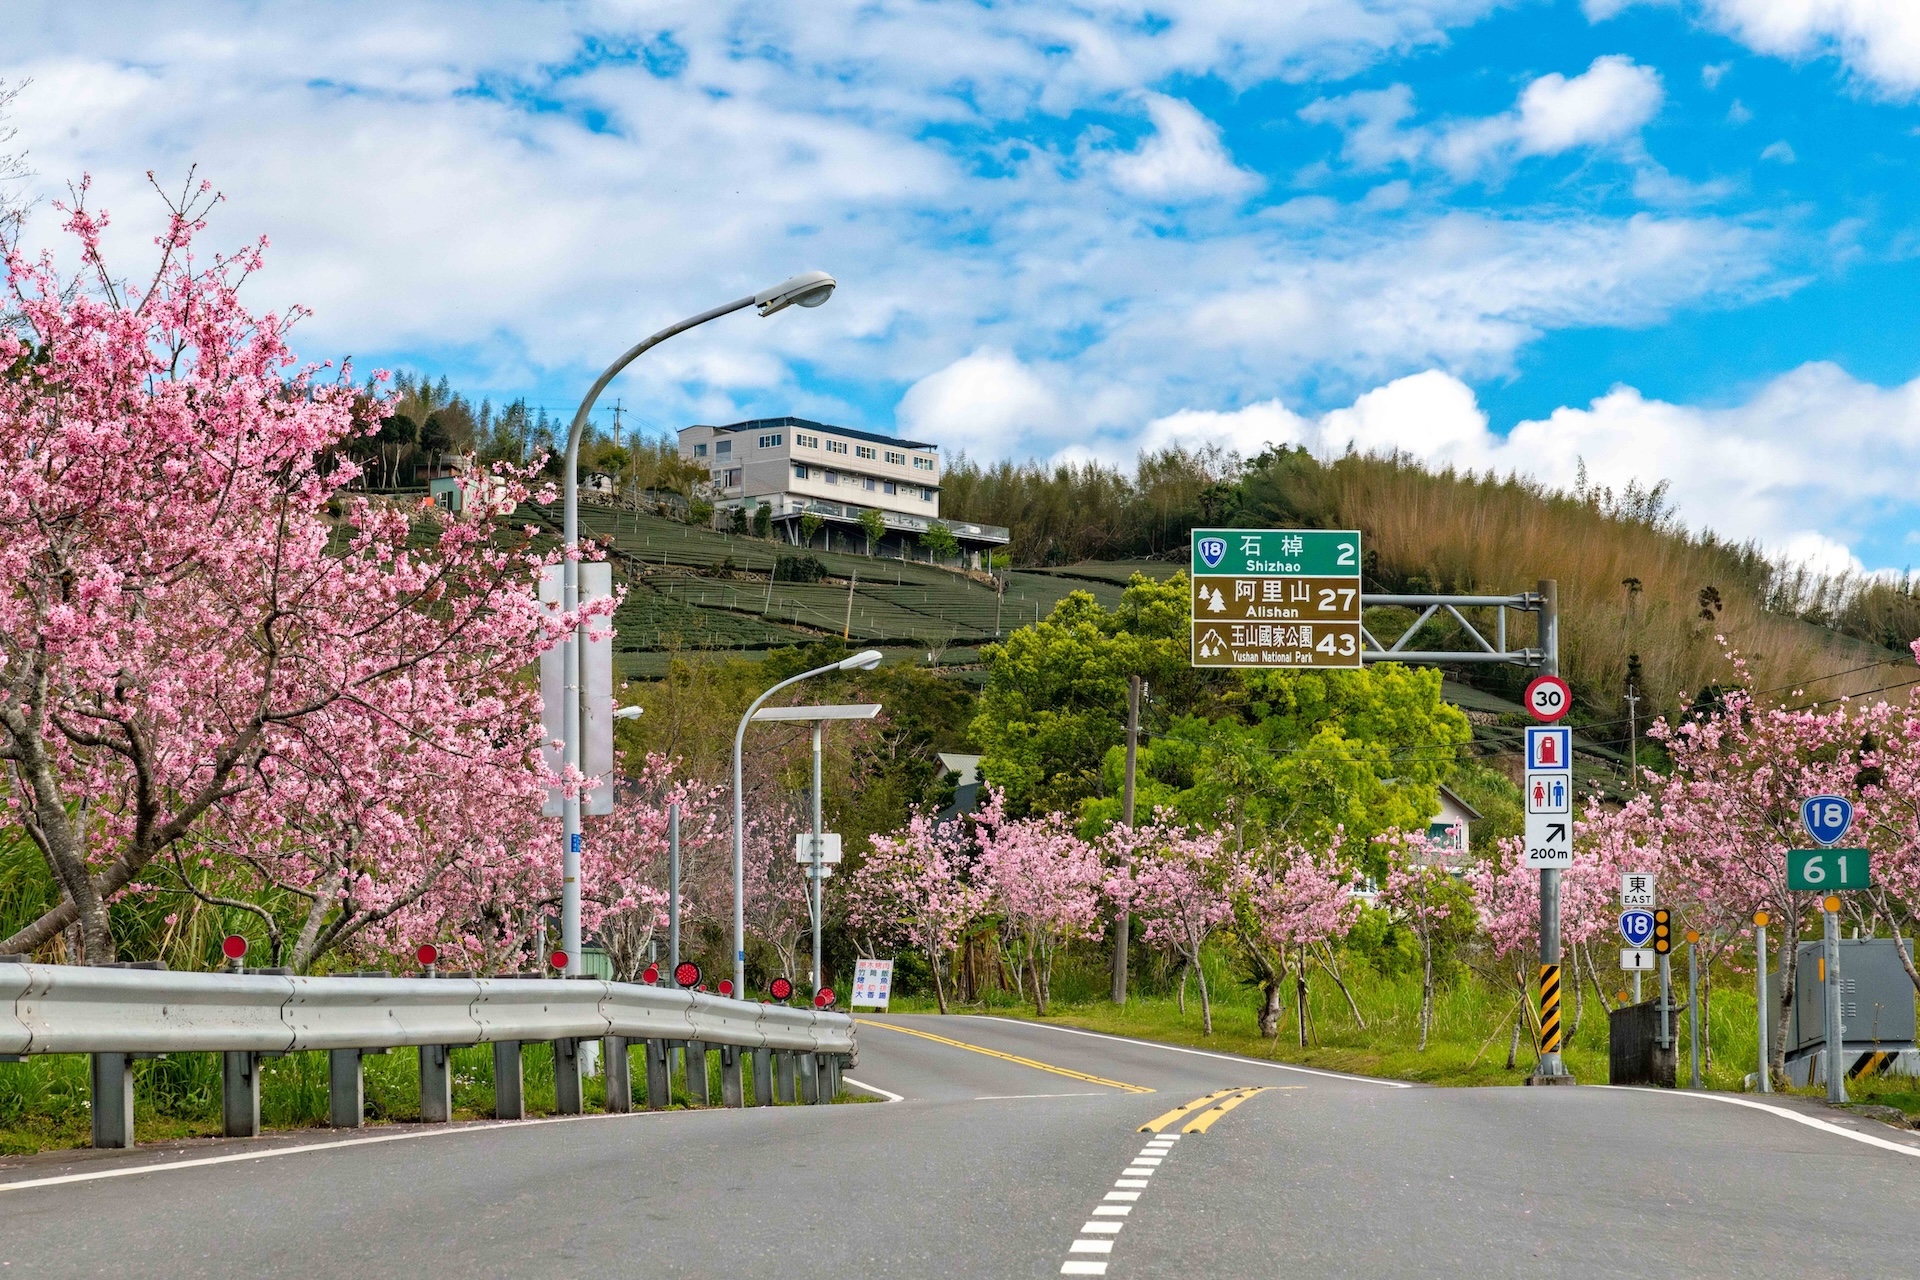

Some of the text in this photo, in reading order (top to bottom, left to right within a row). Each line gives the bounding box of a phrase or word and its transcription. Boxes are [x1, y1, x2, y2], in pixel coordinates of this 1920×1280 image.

[1203, 542, 1221, 557] 18
[1239, 535, 1304, 557] 石棹
[1336, 543, 1355, 566] 2
[1246, 560, 1301, 572] Shizhao
[1235, 580, 1310, 602] 阿里山
[1318, 588, 1356, 611] 27
[1246, 605, 1299, 618] Alishan
[1231, 625, 1313, 648] 玉山國家公園
[1316, 633, 1356, 656] 43
[1232, 650, 1313, 663] Yushan National Park
[1535, 691, 1561, 707] 30
[1812, 803, 1843, 828] 18
[1629, 876, 1646, 893] 東
[1624, 895, 1651, 904] EAST
[1626, 915, 1648, 935] 18
